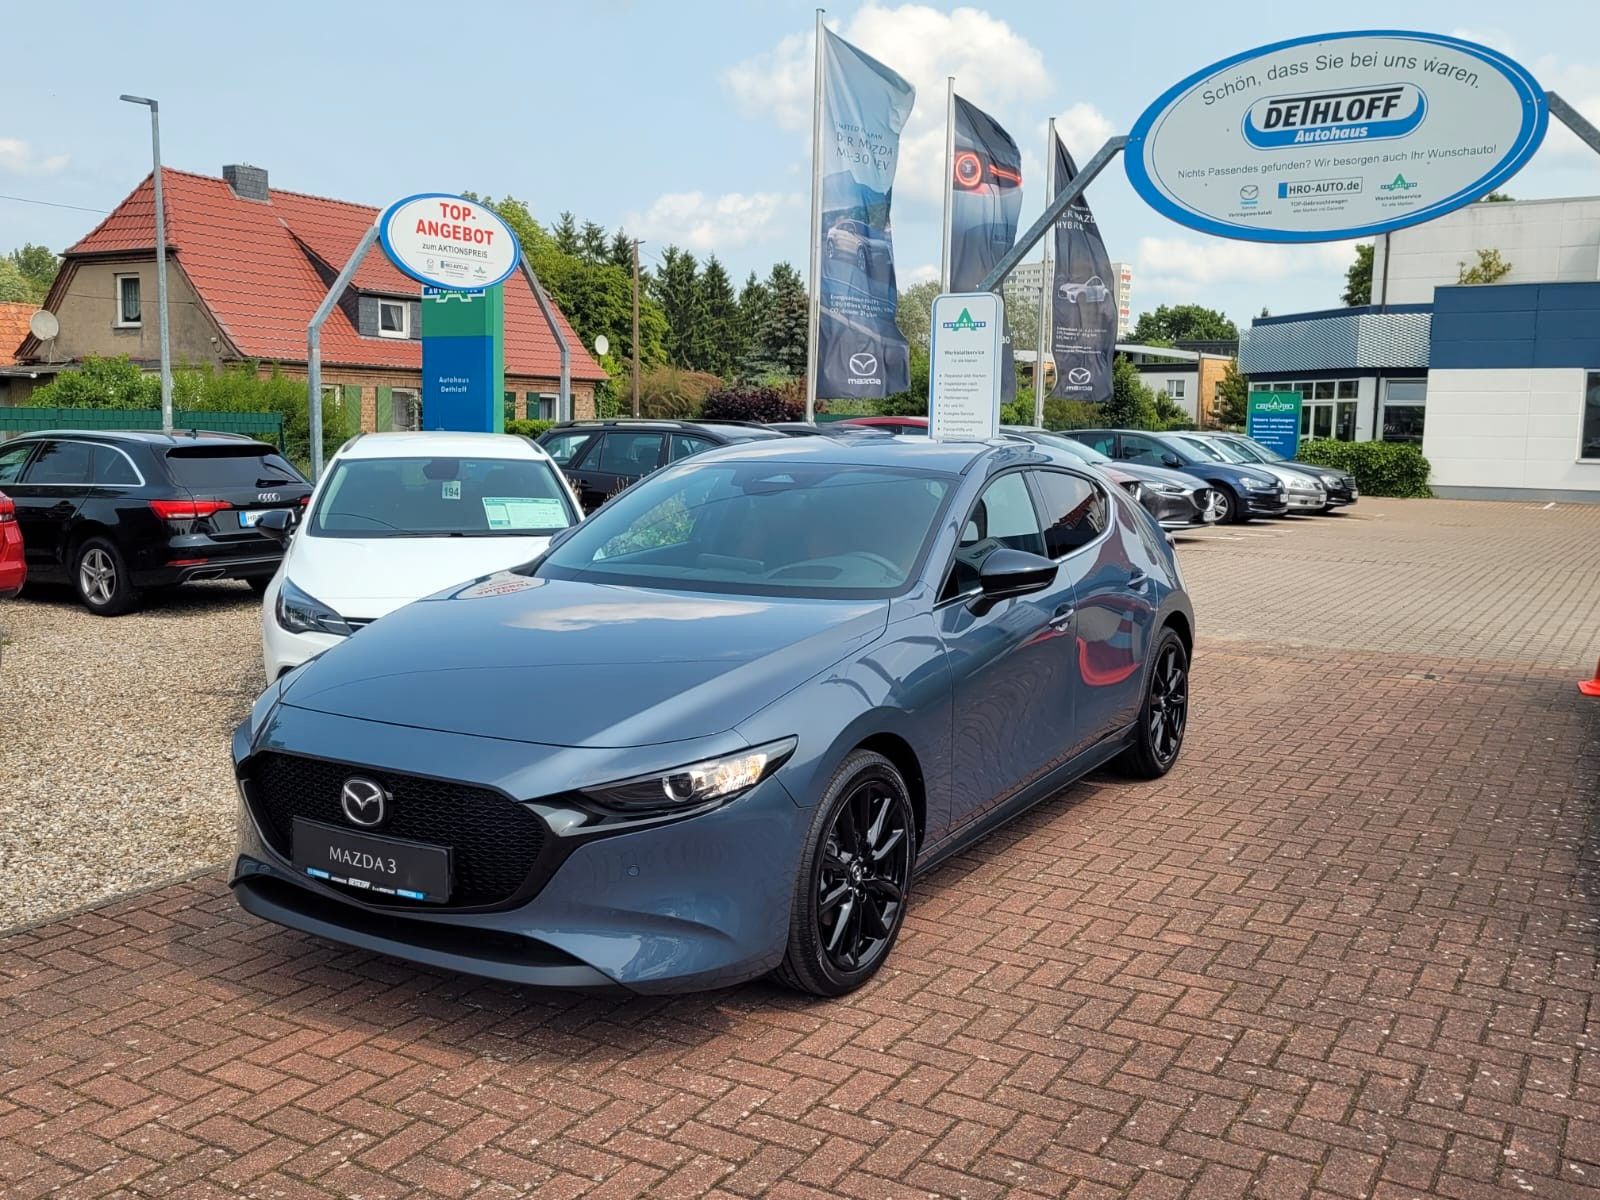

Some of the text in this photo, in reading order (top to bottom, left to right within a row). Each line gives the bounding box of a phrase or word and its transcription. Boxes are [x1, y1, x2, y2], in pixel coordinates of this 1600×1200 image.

[1202, 51, 1480, 105] Schön, dass Sie bei uns waren.
[1263, 87, 1404, 130] DETHLOFF
[1294, 126, 1368, 143] Autohaus
[1178, 144, 1497, 179] Nichts Passendes gefunden? Wir besorgen auch Ihr Wunschauto!
[1288, 180, 1360, 195] HRO-AUTO.de
[440, 202, 477, 222] TOP-
[416, 219, 495, 246] ANGEBOT
[422, 242, 489, 259] zum AKTIONSPREIS
[439, 376, 470, 384] Autohaus
[847, 377, 882, 386] mazda
[440, 385, 467, 393] Dethloff
[444, 487, 459, 497] 194
[329, 846, 397, 874] MAZDA 3
